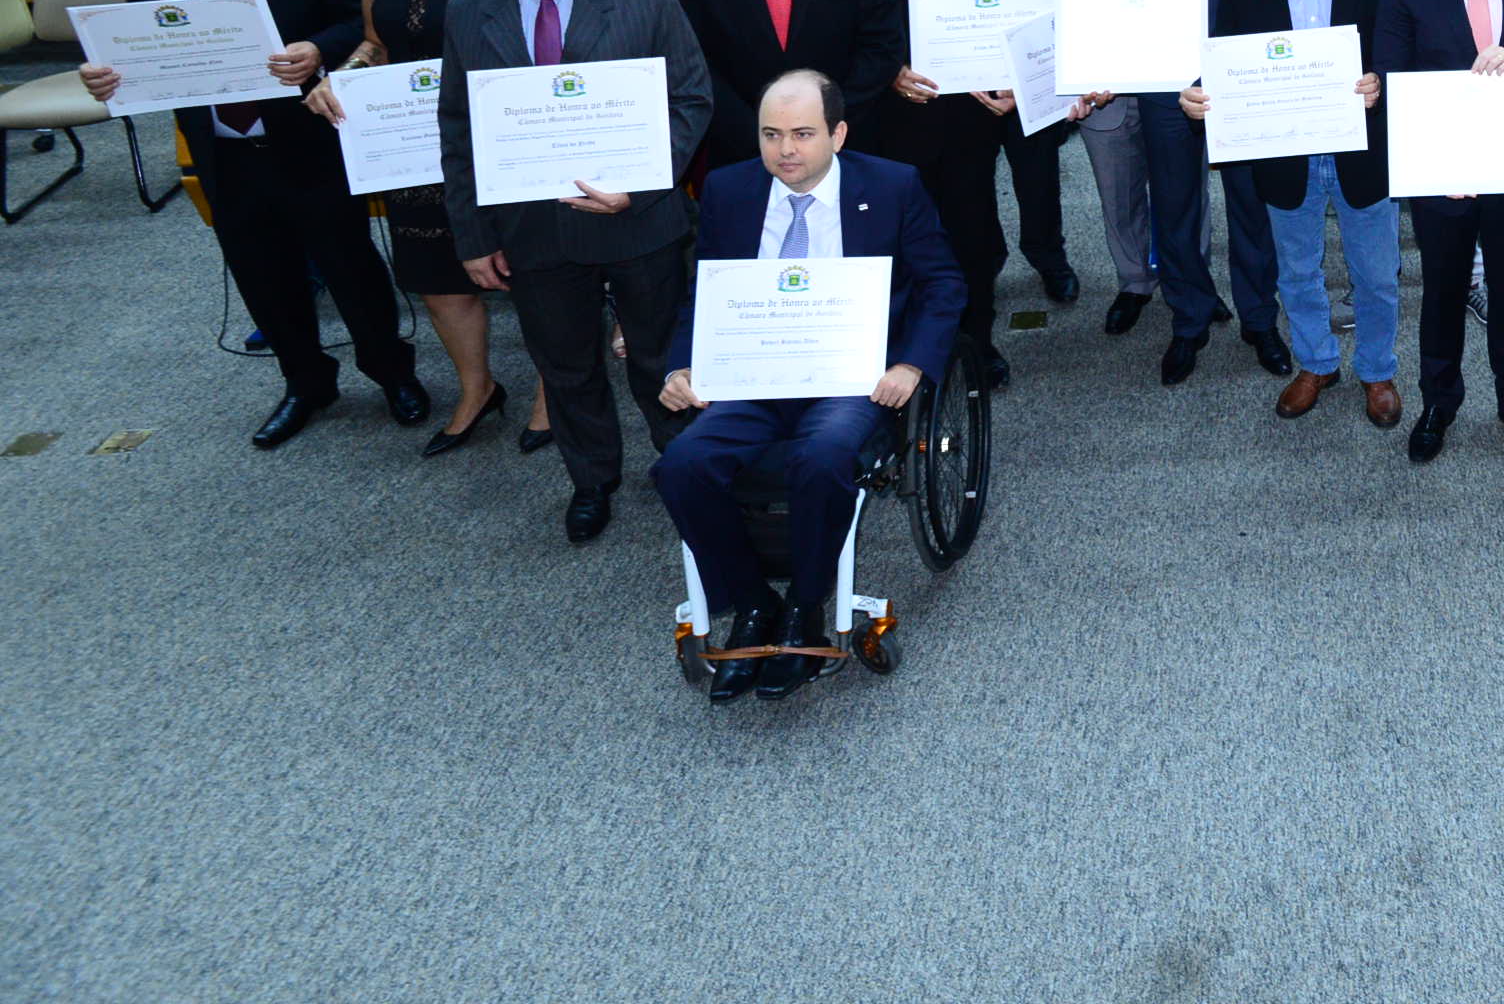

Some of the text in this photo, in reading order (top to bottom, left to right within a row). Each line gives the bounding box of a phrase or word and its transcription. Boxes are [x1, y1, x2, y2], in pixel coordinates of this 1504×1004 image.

[1227, 68, 1258, 76] Diploma
[1260, 66, 1269, 74] de
[366, 102, 402, 113] Diploma
[404, 99, 414, 107] de
[504, 99, 636, 117] Diploma de Honra ao Mérito
[727, 299, 765, 309] Diploma
[768, 299, 777, 307] de
[781, 298, 809, 307] Honra
